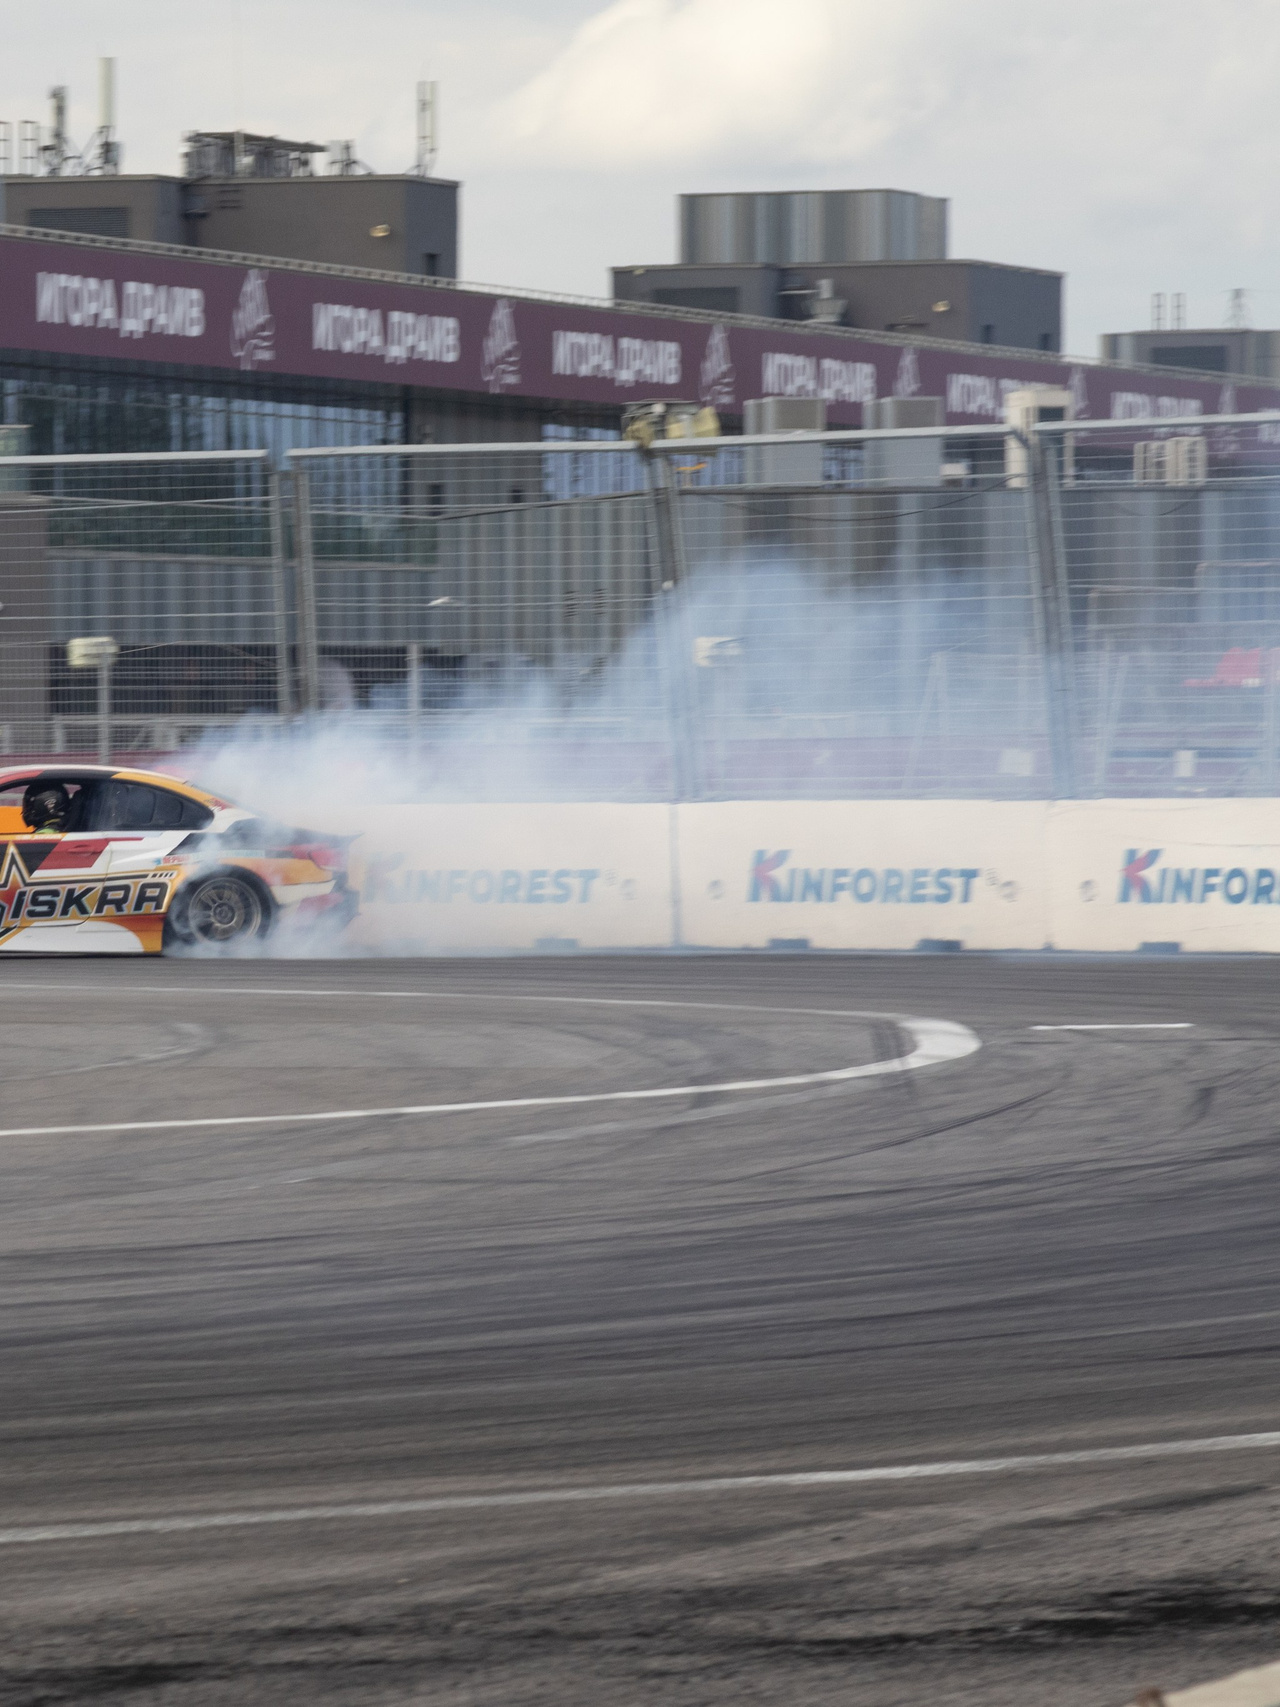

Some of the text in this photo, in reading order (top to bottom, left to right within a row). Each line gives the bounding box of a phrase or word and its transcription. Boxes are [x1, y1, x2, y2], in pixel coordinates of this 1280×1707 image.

[9, 881, 169, 920] ISKRA
[746, 848, 982, 904] KINFOREST
[1116, 847, 1280, 905] KINFOR
